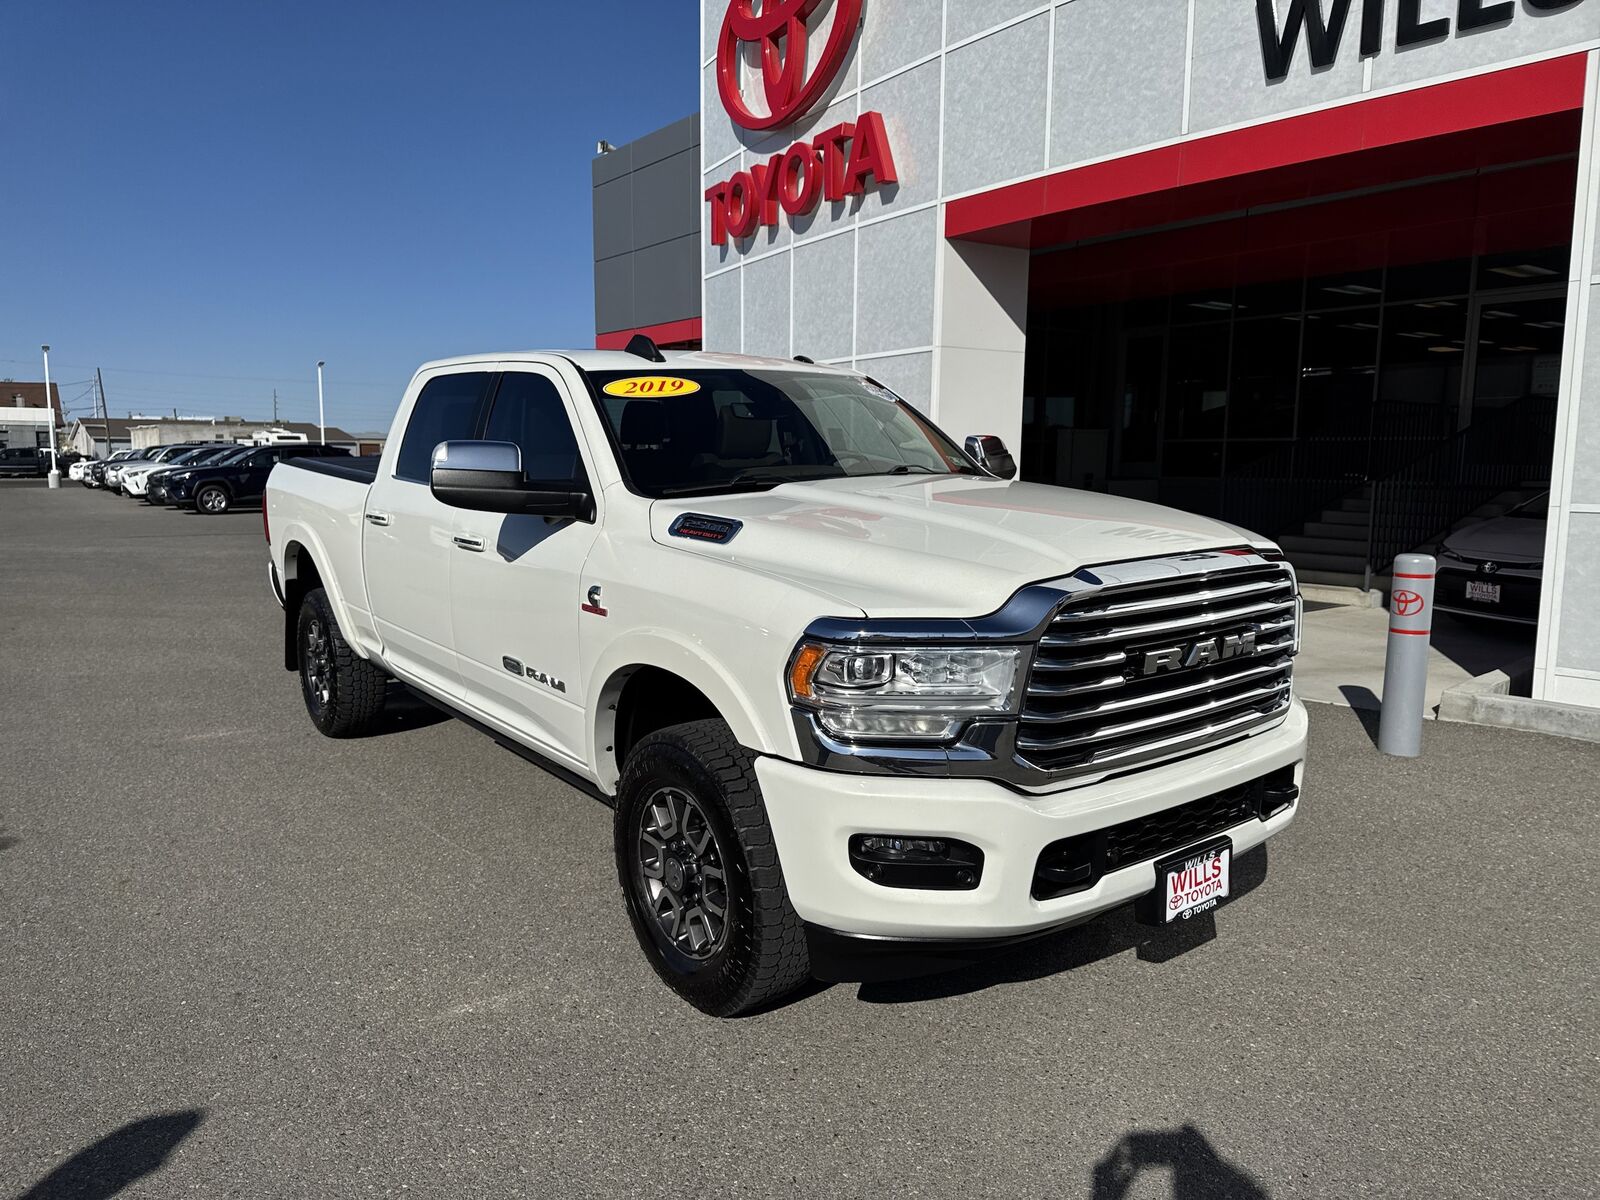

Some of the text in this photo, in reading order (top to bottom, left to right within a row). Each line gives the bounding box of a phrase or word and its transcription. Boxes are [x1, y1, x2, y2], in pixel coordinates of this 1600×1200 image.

[1255, 0, 1584, 80] WIL
[705, 110, 898, 246] TOYOTA
[624, 380, 684, 394] 2019
[679, 528, 703, 536] HEAVY
[684, 520, 731, 533] 2500
[1471, 584, 1497, 595] WILLS
[1143, 631, 1256, 675] RAM
[526, 666, 566, 693] RAM
[1184, 850, 1216, 870] WILLS
[1171, 857, 1222, 895] WILLS
[1184, 879, 1222, 905] TOYOTA
[1193, 898, 1217, 915] TOYOTA
